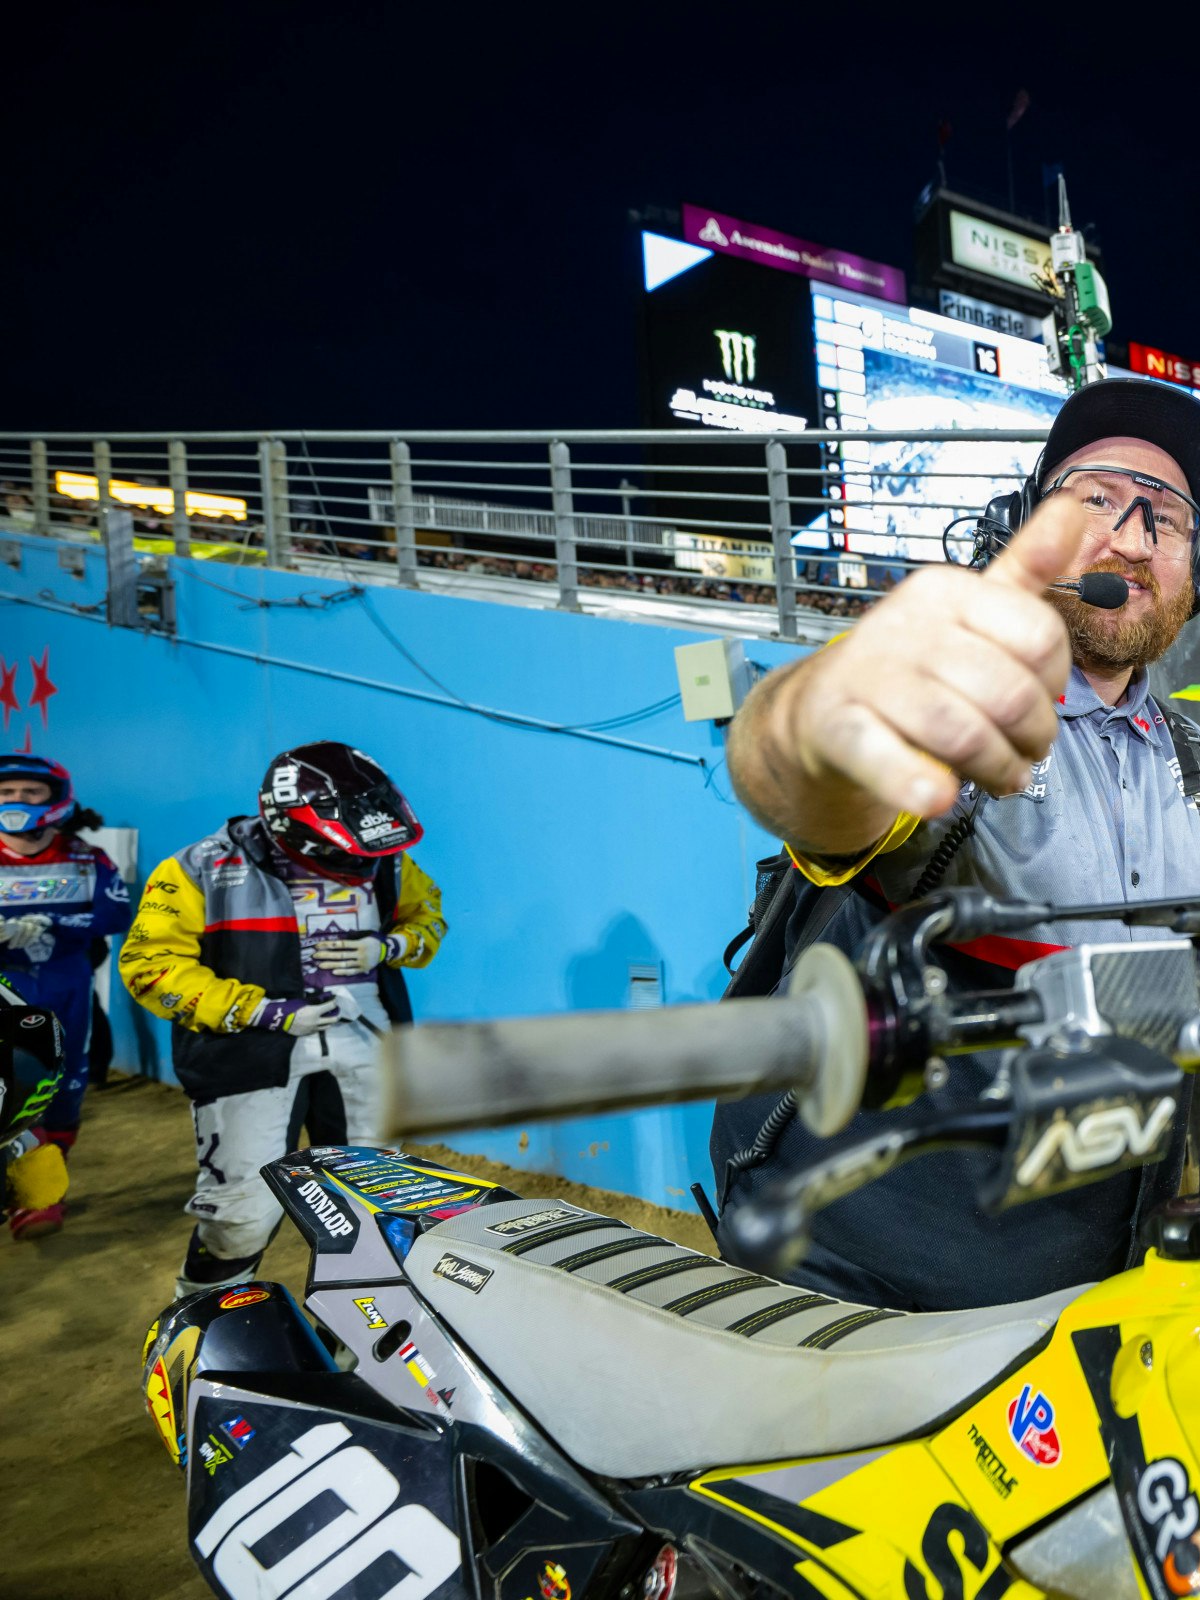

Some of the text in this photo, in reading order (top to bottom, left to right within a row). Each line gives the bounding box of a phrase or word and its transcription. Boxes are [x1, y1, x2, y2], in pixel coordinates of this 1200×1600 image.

[730, 230, 800, 262] Ascension
[971, 230, 1040, 265] NISS
[942, 294, 1024, 336] Pinnacle
[1134, 476, 1161, 489] SCOTT
[272, 765, 299, 803] 100
[1016, 1097, 1177, 1187] ASV
[297, 1179, 354, 1239] DUNLOP
[1011, 1386, 1054, 1443] VP
